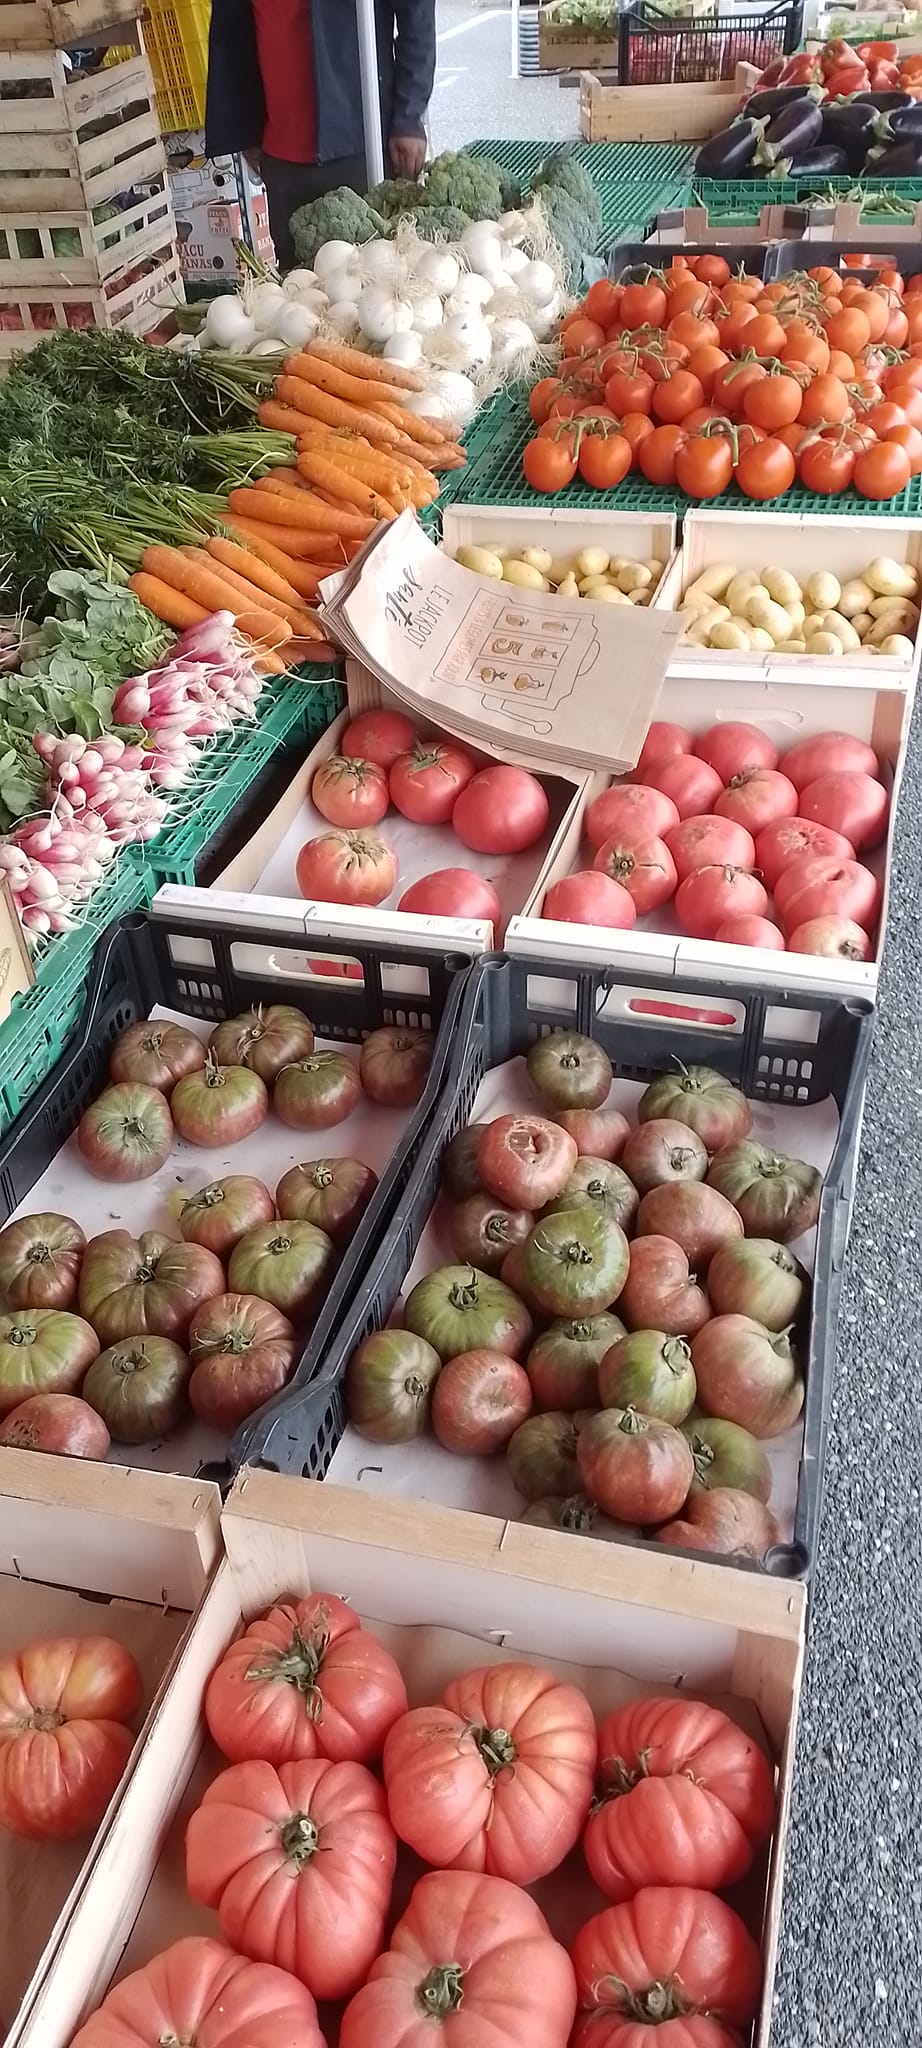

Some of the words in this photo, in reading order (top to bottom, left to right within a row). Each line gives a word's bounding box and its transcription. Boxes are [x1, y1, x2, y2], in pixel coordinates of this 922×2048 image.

[385, 565, 422, 627] santé
[431, 585, 453, 604] LE
[404, 597, 443, 649] JACKPOT
[492, 638, 523, 656] 5
